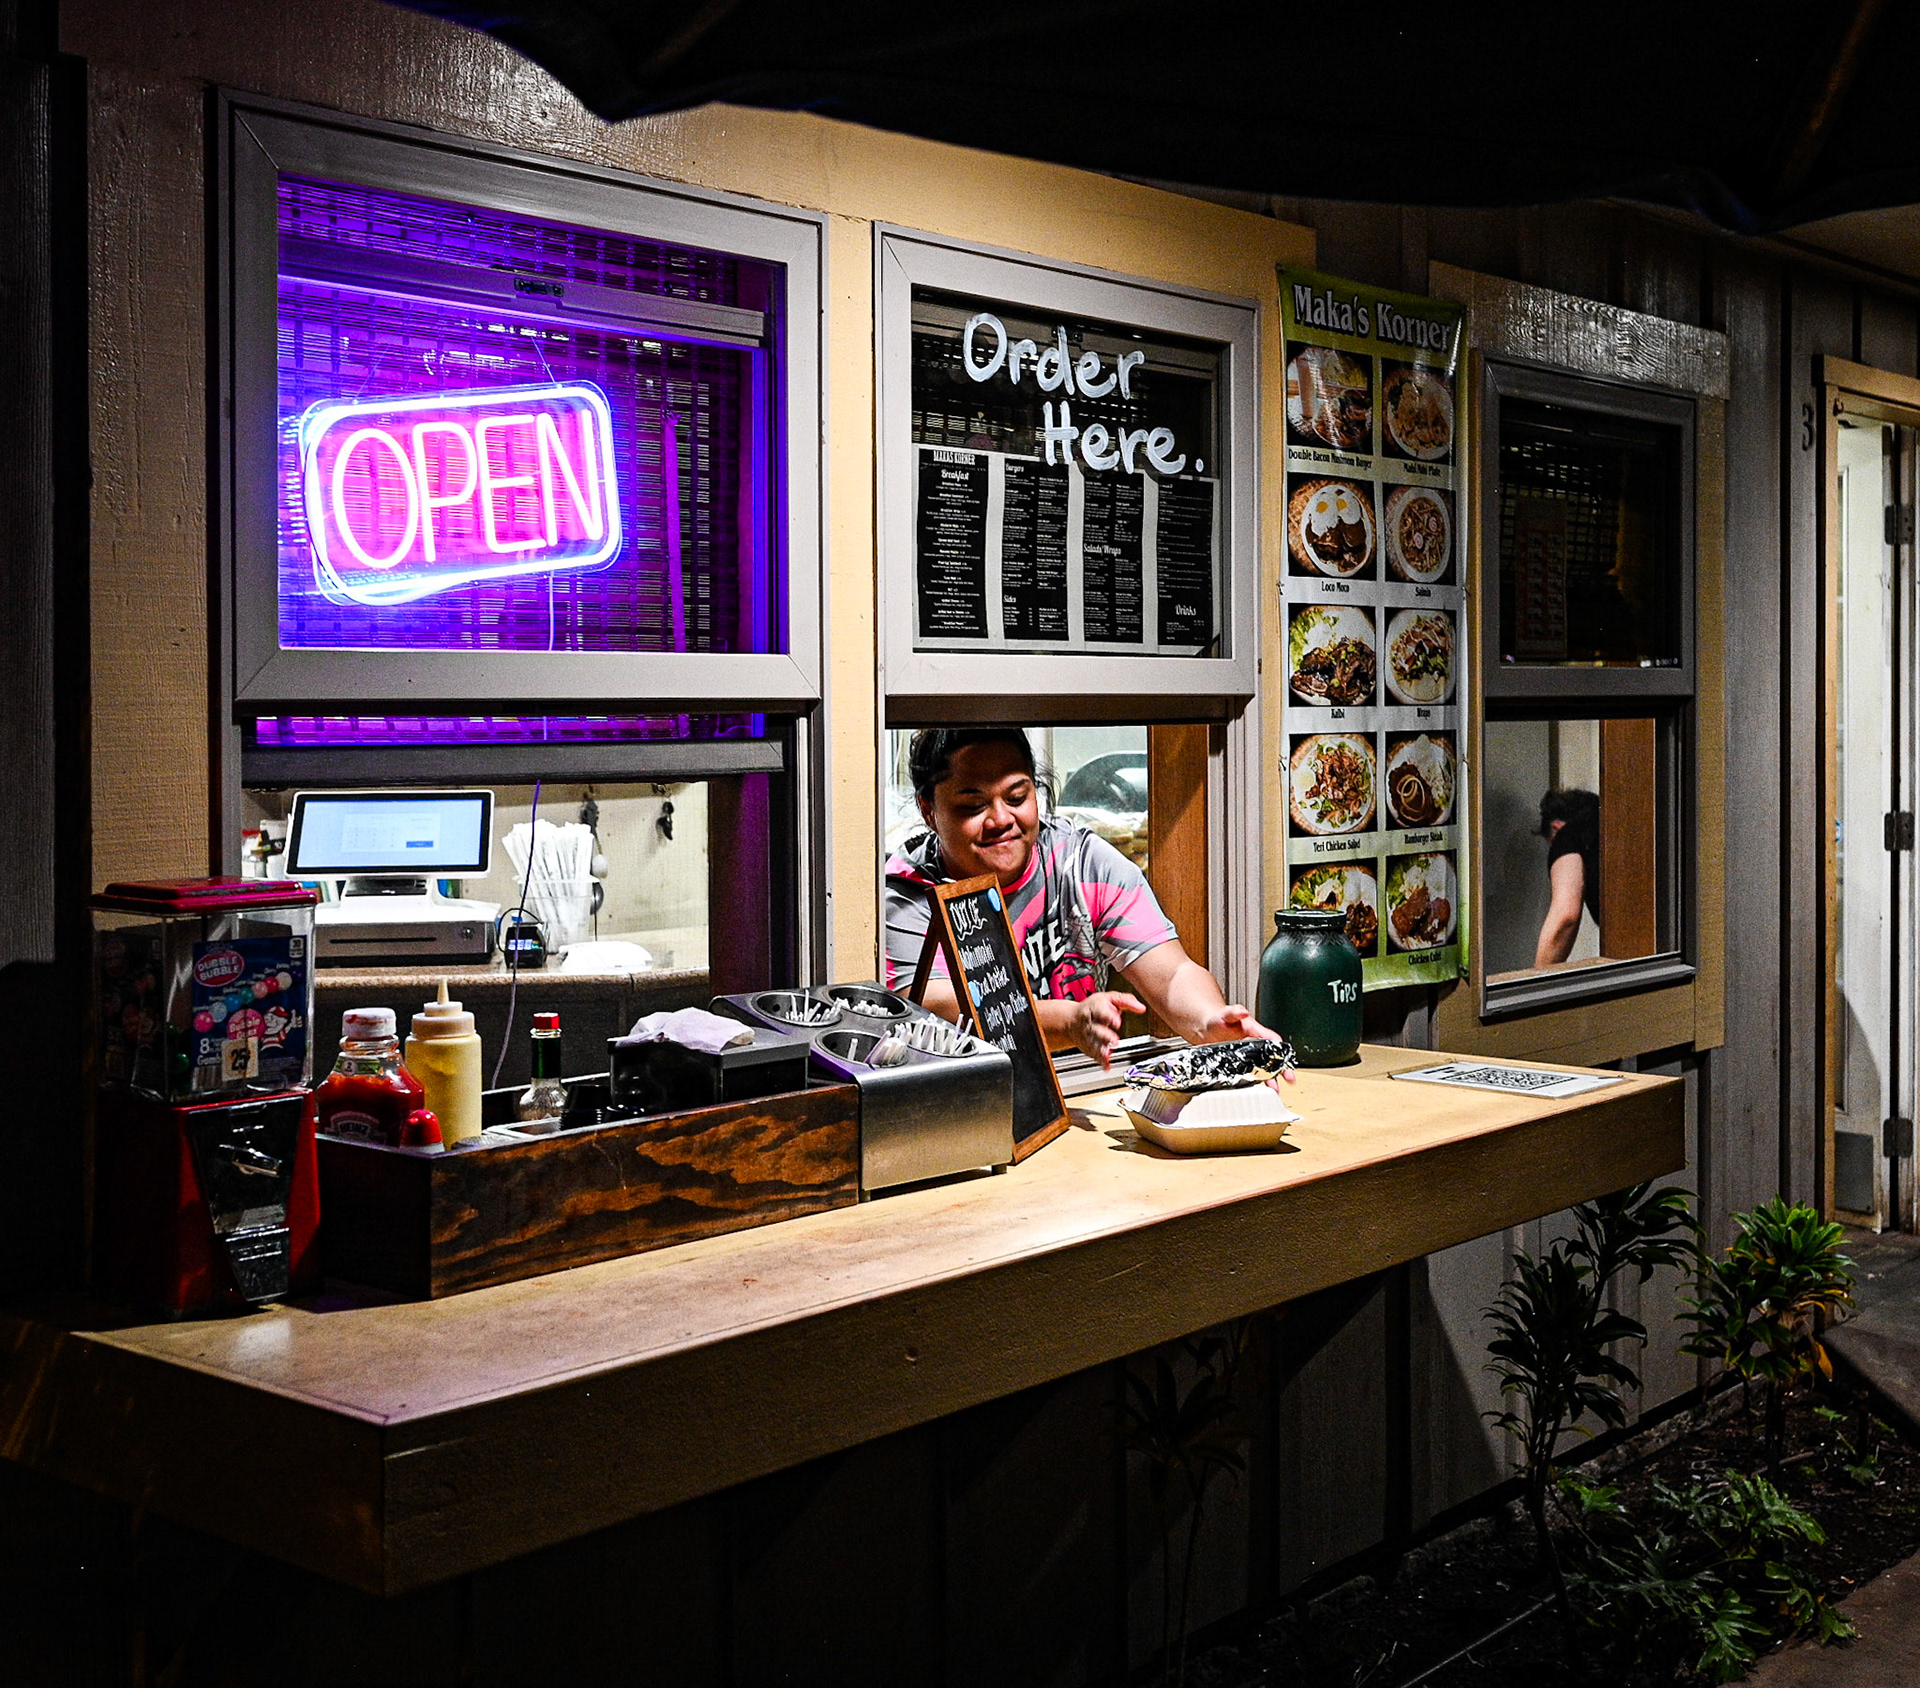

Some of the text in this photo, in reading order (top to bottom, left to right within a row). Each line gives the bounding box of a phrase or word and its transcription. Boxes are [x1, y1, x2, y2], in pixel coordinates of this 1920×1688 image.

[1292, 283, 1452, 351] Maka's Korner
[963, 312, 1145, 400] Order
[1802, 404, 1814, 451] 3
[1043, 401, 1204, 475] Here.
[1288, 448, 1312, 461] Double
[1312, 450, 1330, 463] Bacon
[1355, 456, 1372, 470] Burger
[941, 469, 970, 482] Breakfast
[332, 409, 604, 569] OPEN
[1321, 581, 1350, 593] Loco Moco
[1313, 841, 1325, 853] Teri
[1325, 840, 1347, 852] Chicken
[197, 956, 239, 973] DUBBLE
[1408, 953, 1430, 965] Chicken
[199, 964, 241, 982] BUBBLE
[199, 1037, 210, 1054] 8
[339, 1122, 369, 1135] HEINZ
